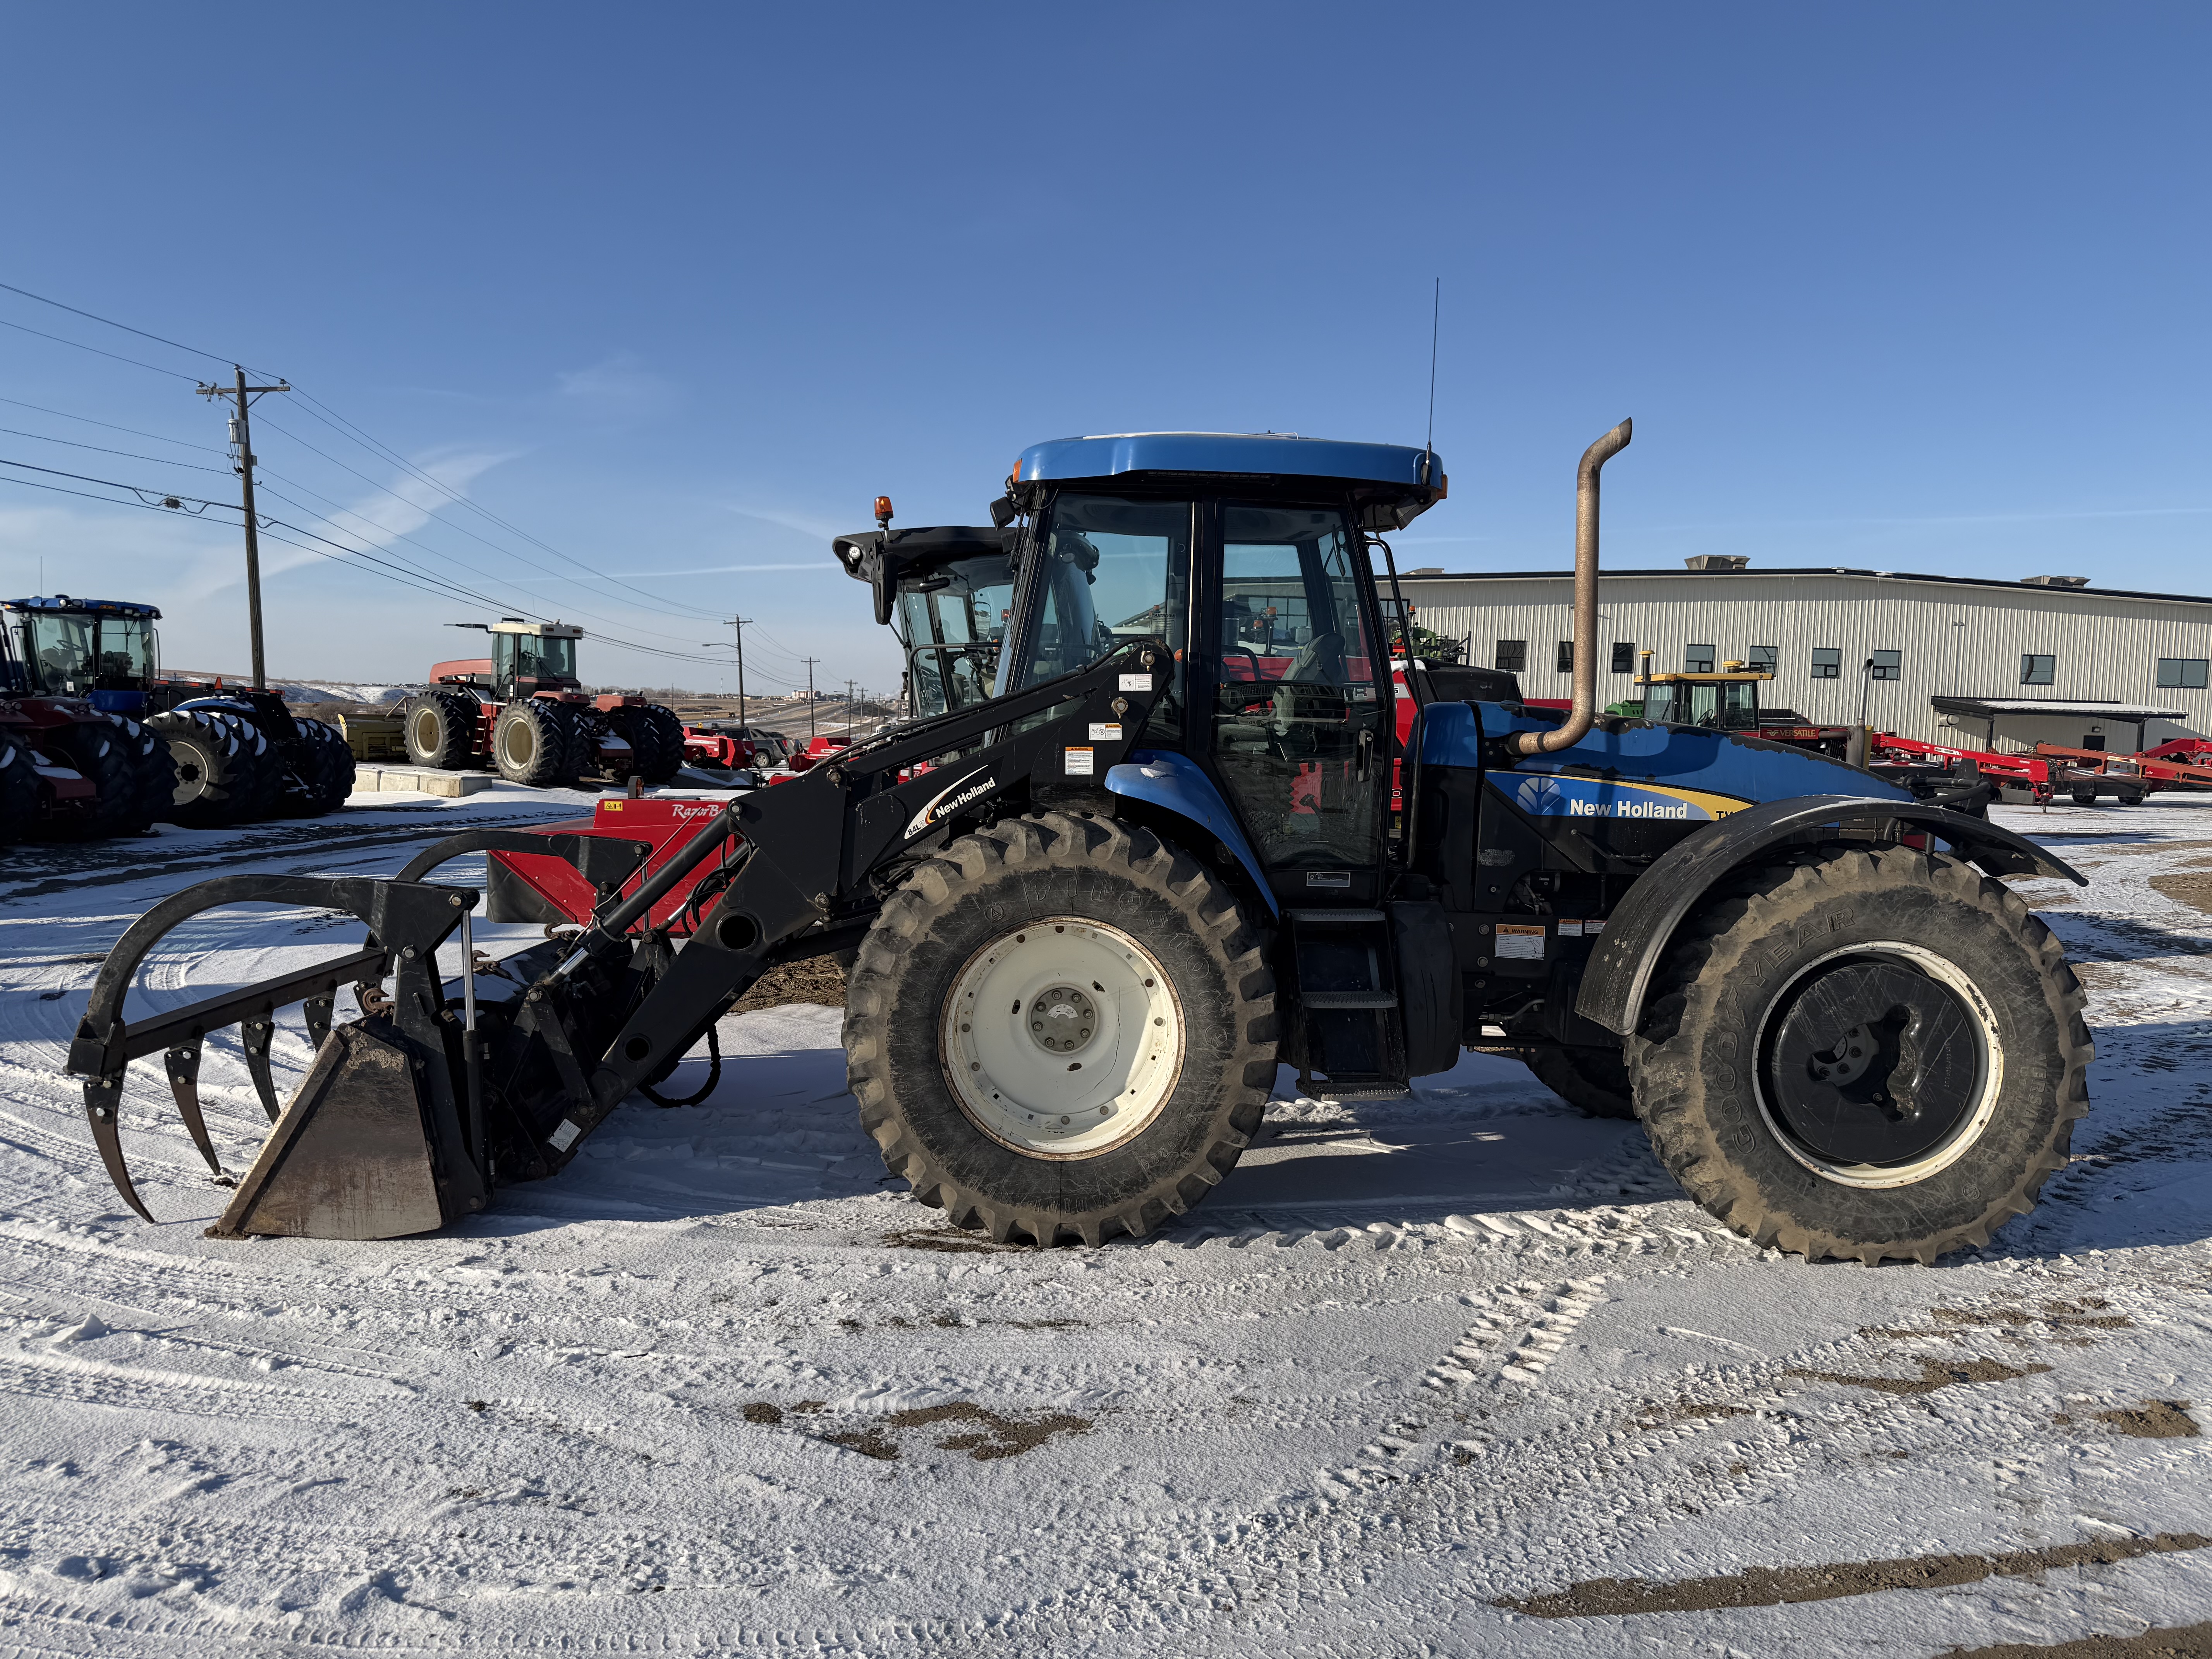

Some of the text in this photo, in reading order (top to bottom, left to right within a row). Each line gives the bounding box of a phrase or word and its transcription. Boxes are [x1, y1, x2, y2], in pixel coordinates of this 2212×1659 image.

[672, 804, 726, 819] RazorB
[1570, 799, 1687, 819] New Holland
[1715, 906, 1856, 1154] GOODYEAR
